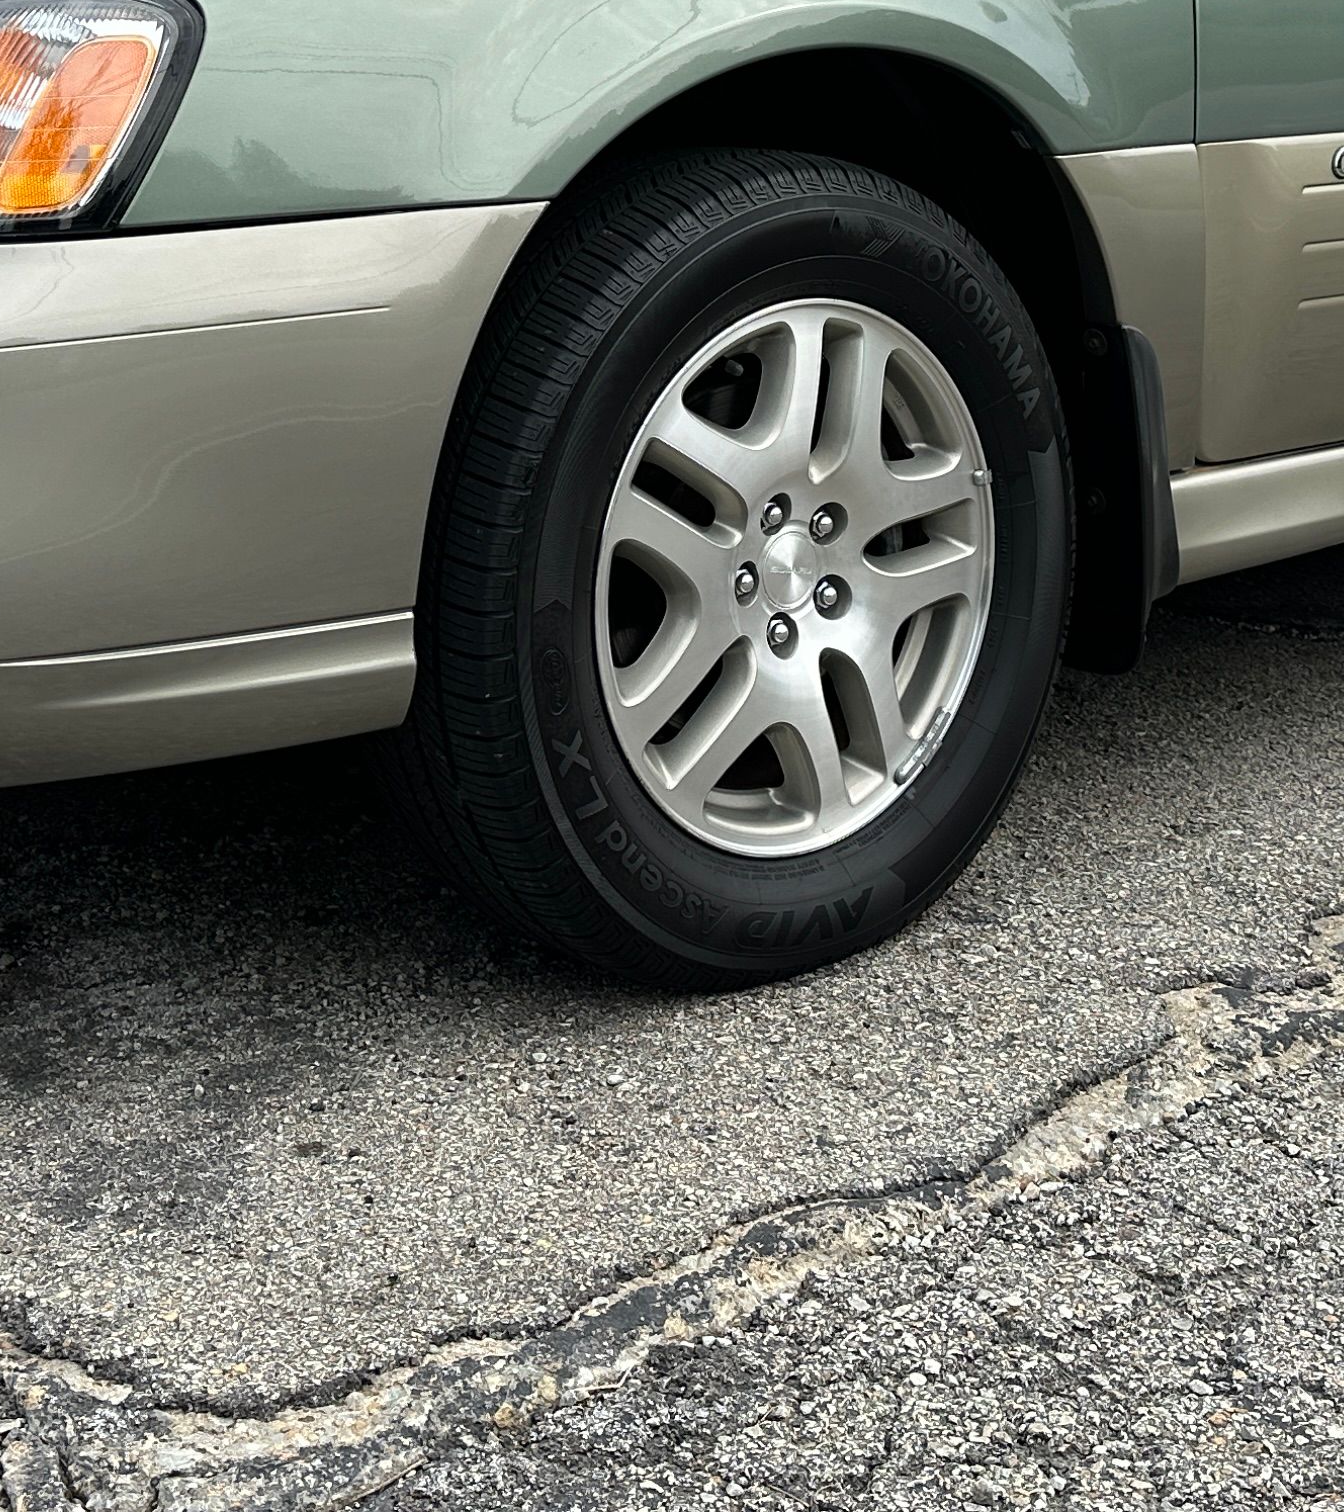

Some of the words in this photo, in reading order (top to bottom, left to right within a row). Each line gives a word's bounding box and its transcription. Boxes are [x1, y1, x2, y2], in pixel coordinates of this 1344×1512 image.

[910, 233, 1041, 420] YOKOHAMA
[552, 729, 609, 821] LX
[597, 819, 729, 933] Ascend
[734, 887, 874, 949] AVID
